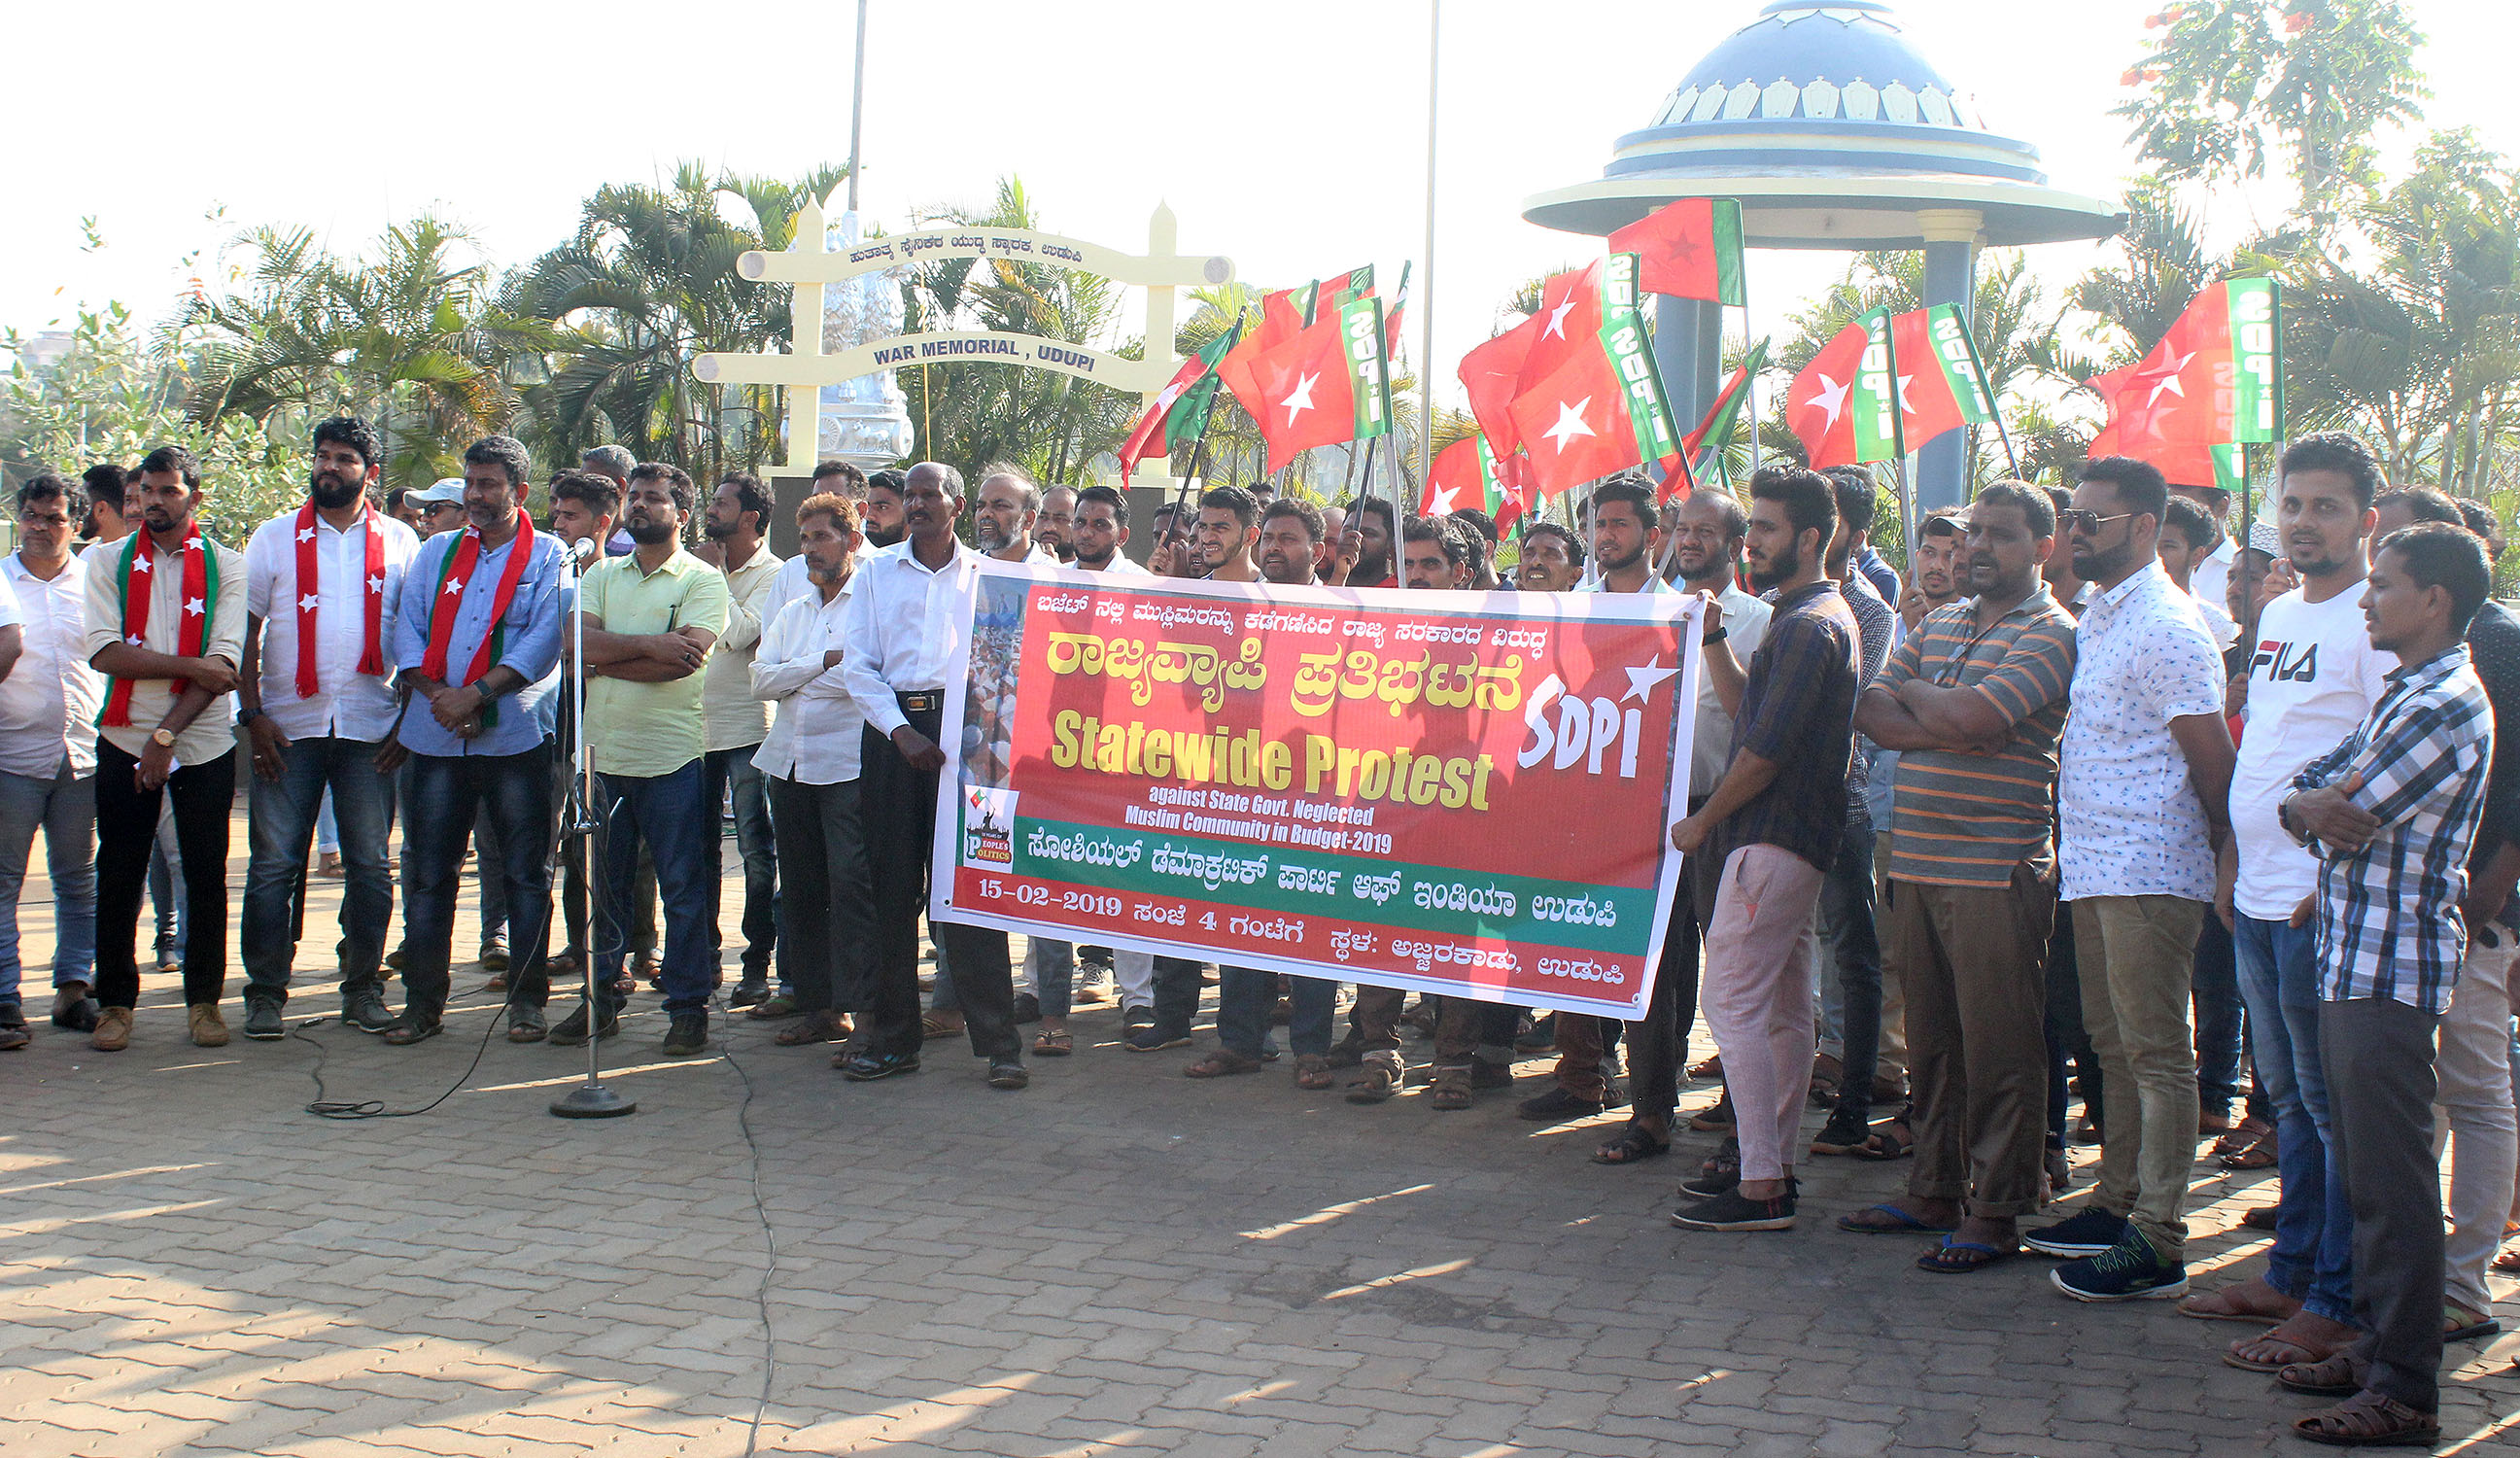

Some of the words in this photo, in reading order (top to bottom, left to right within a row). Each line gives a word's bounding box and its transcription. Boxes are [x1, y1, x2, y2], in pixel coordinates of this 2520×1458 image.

[849, 241, 894, 263] ಹುತಾತ್ಮ
[901, 235, 944, 258] ಸೈನಿಕರ
[951, 233, 986, 255] ಯುದ್ಧ
[1042, 244, 1083, 262] ಉಡುಪಿ
[874, 345, 915, 365] WAR
[921, 340, 1019, 357] MEMORIAL
[1037, 345, 1096, 372] UDUPI
[1037, 593, 1089, 614] ಬಜೆಟ್
[1095, 598, 1125, 625] ನಲ್ಲಿ
[1133, 601, 1234, 636] ಮುಸ್ಲಿಮರನ್ನು
[1342, 618, 1386, 648] ರಾಜ್ಯ
[1395, 620, 1484, 644] ಸರಕಾರದ
[1491, 626, 1548, 661] ವಿರುದ್ಧ
[1047, 631, 1267, 713] ರಾಜ್ಯವ್ಯಾಪಿ
[1290, 642, 1524, 717] ಪ್ರತಿಭಟನೆ
[2249, 640, 2318, 682] FILA
[1051, 709, 1293, 791] Statewide
[1305, 734, 1495, 812] Protest
[1124, 805, 1181, 829] Muslim
[1183, 812, 1271, 842] Community
[1272, 821, 1289, 842] in
[1291, 823, 1393, 854] Budget-2019
[1149, 785, 1207, 808] against
[1208, 789, 1250, 813] State
[1251, 794, 1290, 817] Govt.
[1293, 799, 1375, 826] Neglected
[1028, 826, 1143, 868] ಸೋಶಿಯಲ್
[1151, 842, 1269, 891] ಡೆಮಾಕ್ರಟಿಕ್
[1278, 863, 1341, 895] ಪಾರ್ಟಿ
[1353, 870, 1401, 907] ಆಫ್
[1413, 881, 1517, 918] ಇಂಡಿಯಾ
[1532, 891, 1617, 927] ಉಡುಪಿ
[979, 878, 1122, 917] 15-02-2019
[1133, 900, 1187, 926] ಸಂಜೆ
[1198, 911, 1218, 931] 4
[1229, 914, 1304, 943] ಗಂಟೆಗೆ
[1329, 927, 1378, 962] ಸ್ಥಳ:
[1392, 939, 1523, 974] ಅಜ್ಜರಕಾಡು,
[1537, 957, 1625, 985] ಉಡುಪಿ
